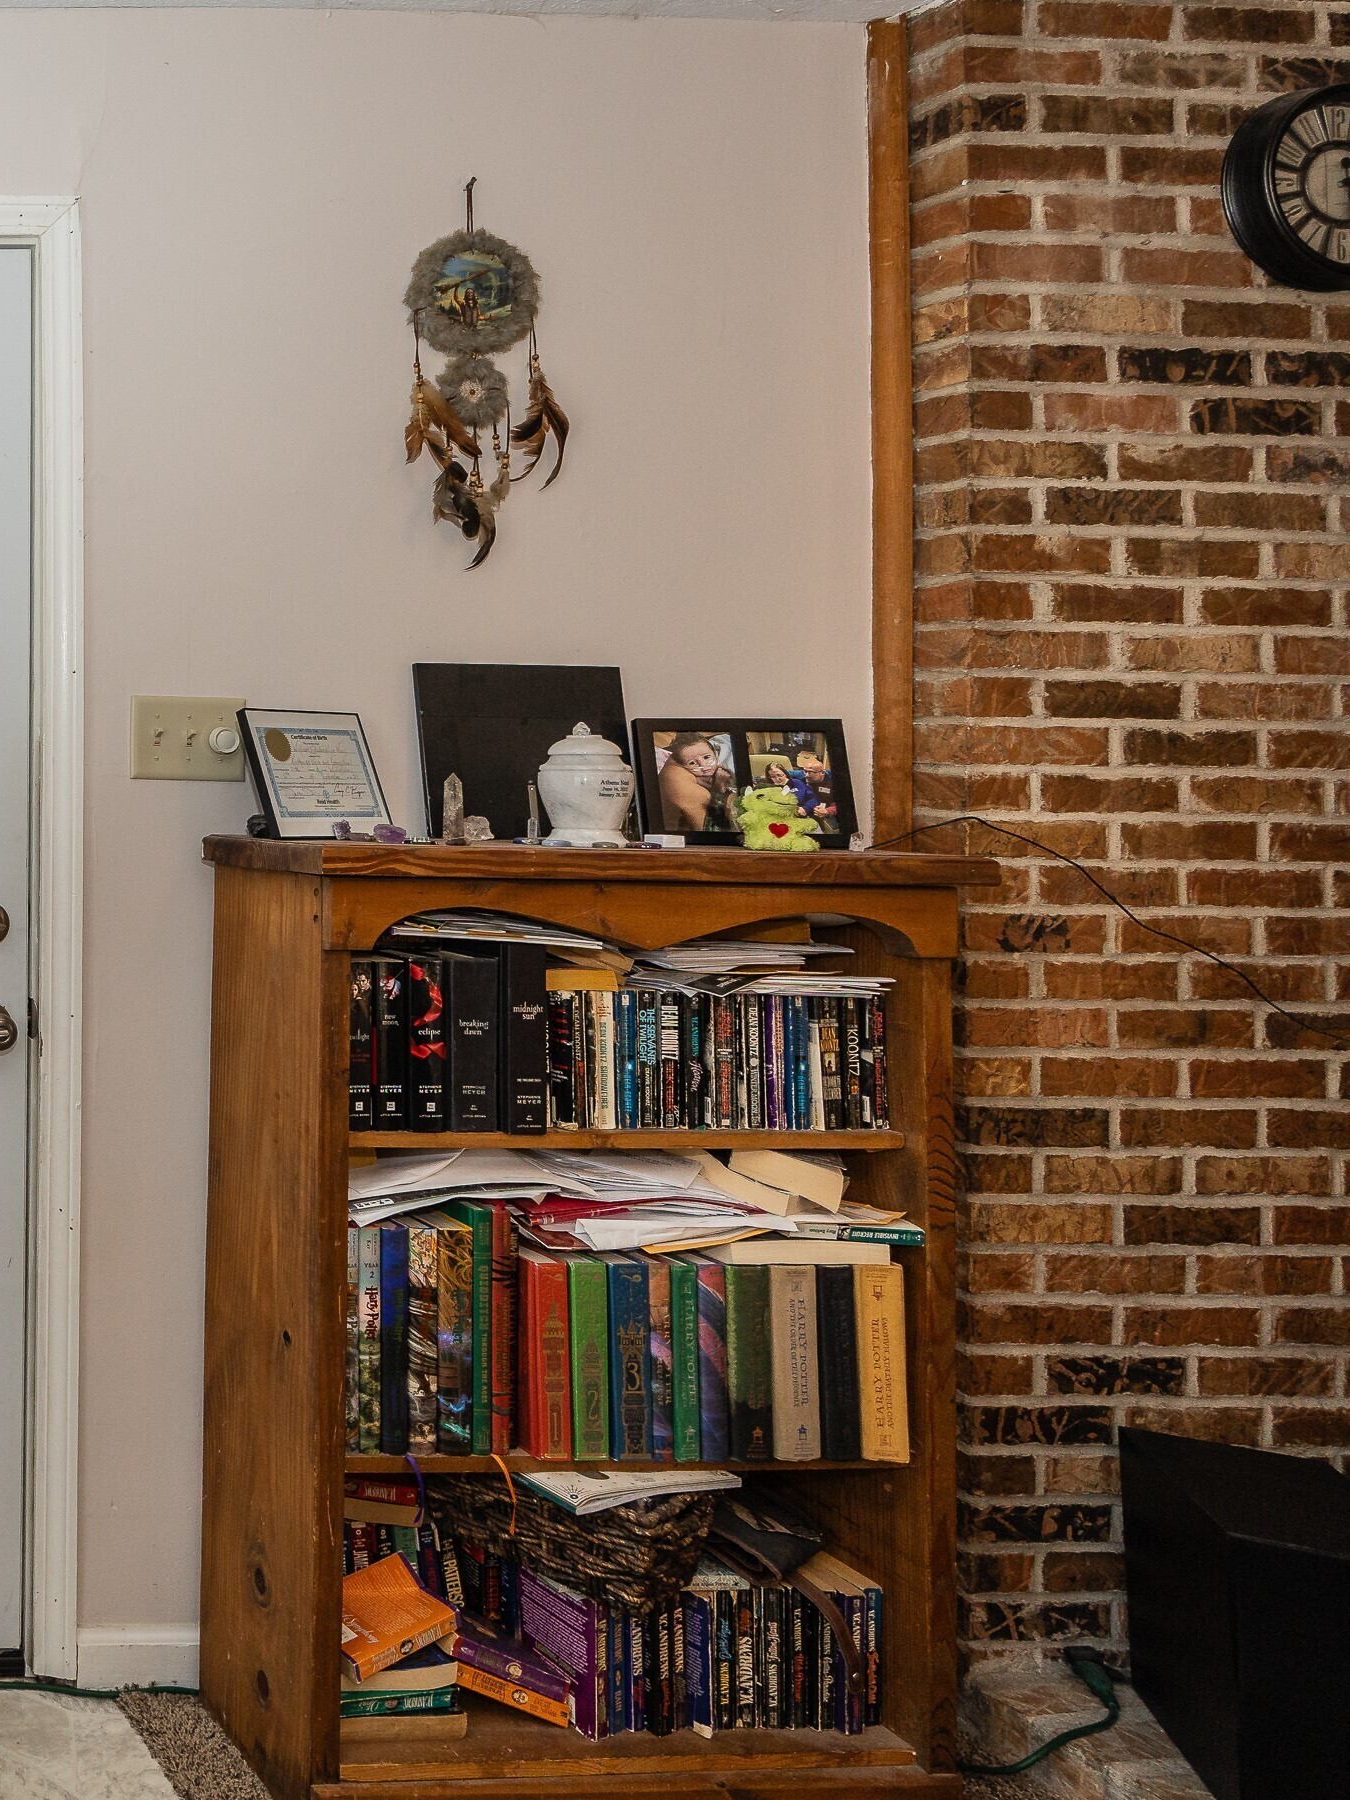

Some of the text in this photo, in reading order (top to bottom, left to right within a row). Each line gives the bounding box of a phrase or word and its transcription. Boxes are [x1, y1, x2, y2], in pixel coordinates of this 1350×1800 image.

[1330, 109, 1346, 139] 12
[459, 1019, 489, 1029] breaking
[512, 1001, 543, 1015] midnight
[522, 1013, 535, 1021] sun
[418, 1028, 441, 1041] eclipse
[599, 1021, 607, 1038] DEAN
[639, 1009, 647, 1062] OF TWILIGHT
[646, 1008, 656, 1066] THE SERVANTS
[661, 1005, 679, 1061] DEAN KOONTZ
[748, 1007, 760, 1114] DEAN KOONTZ WINTER MOON
[847, 1028, 860, 1076] KOONTZ
[599, 1065, 609, 1110] SHADOWFIRES
[688, 1060, 703, 1093] Heaven
[851, 1230, 899, 1240] INVISIBLE RECRUIT
[363, 1285, 380, 1342] Harry Potter
[478, 1265, 489, 1330] QUIDDITCH
[685, 1299, 697, 1405] HARRY POTTER
[797, 1298, 808, 1405] HARRY POTTER
[881, 1317, 890, 1354] HALLOWS
[791, 1352, 797, 1360] OF
[871, 1318, 885, 1428] HARRY POTTER
[884, 1356, 892, 1392] DEATHLY
[626, 1362, 641, 1392] 3
[791, 1373, 799, 1408] PHOENIX
[588, 1391, 599, 1419] 2
[551, 1412, 558, 1441] 1
[353, 1549, 369, 1573] JAME
[443, 1559, 465, 1608] PATTERSO
[632, 1617, 643, 1677] C.ANDREWS
[823, 1618, 831, 1655] ANDREWS
